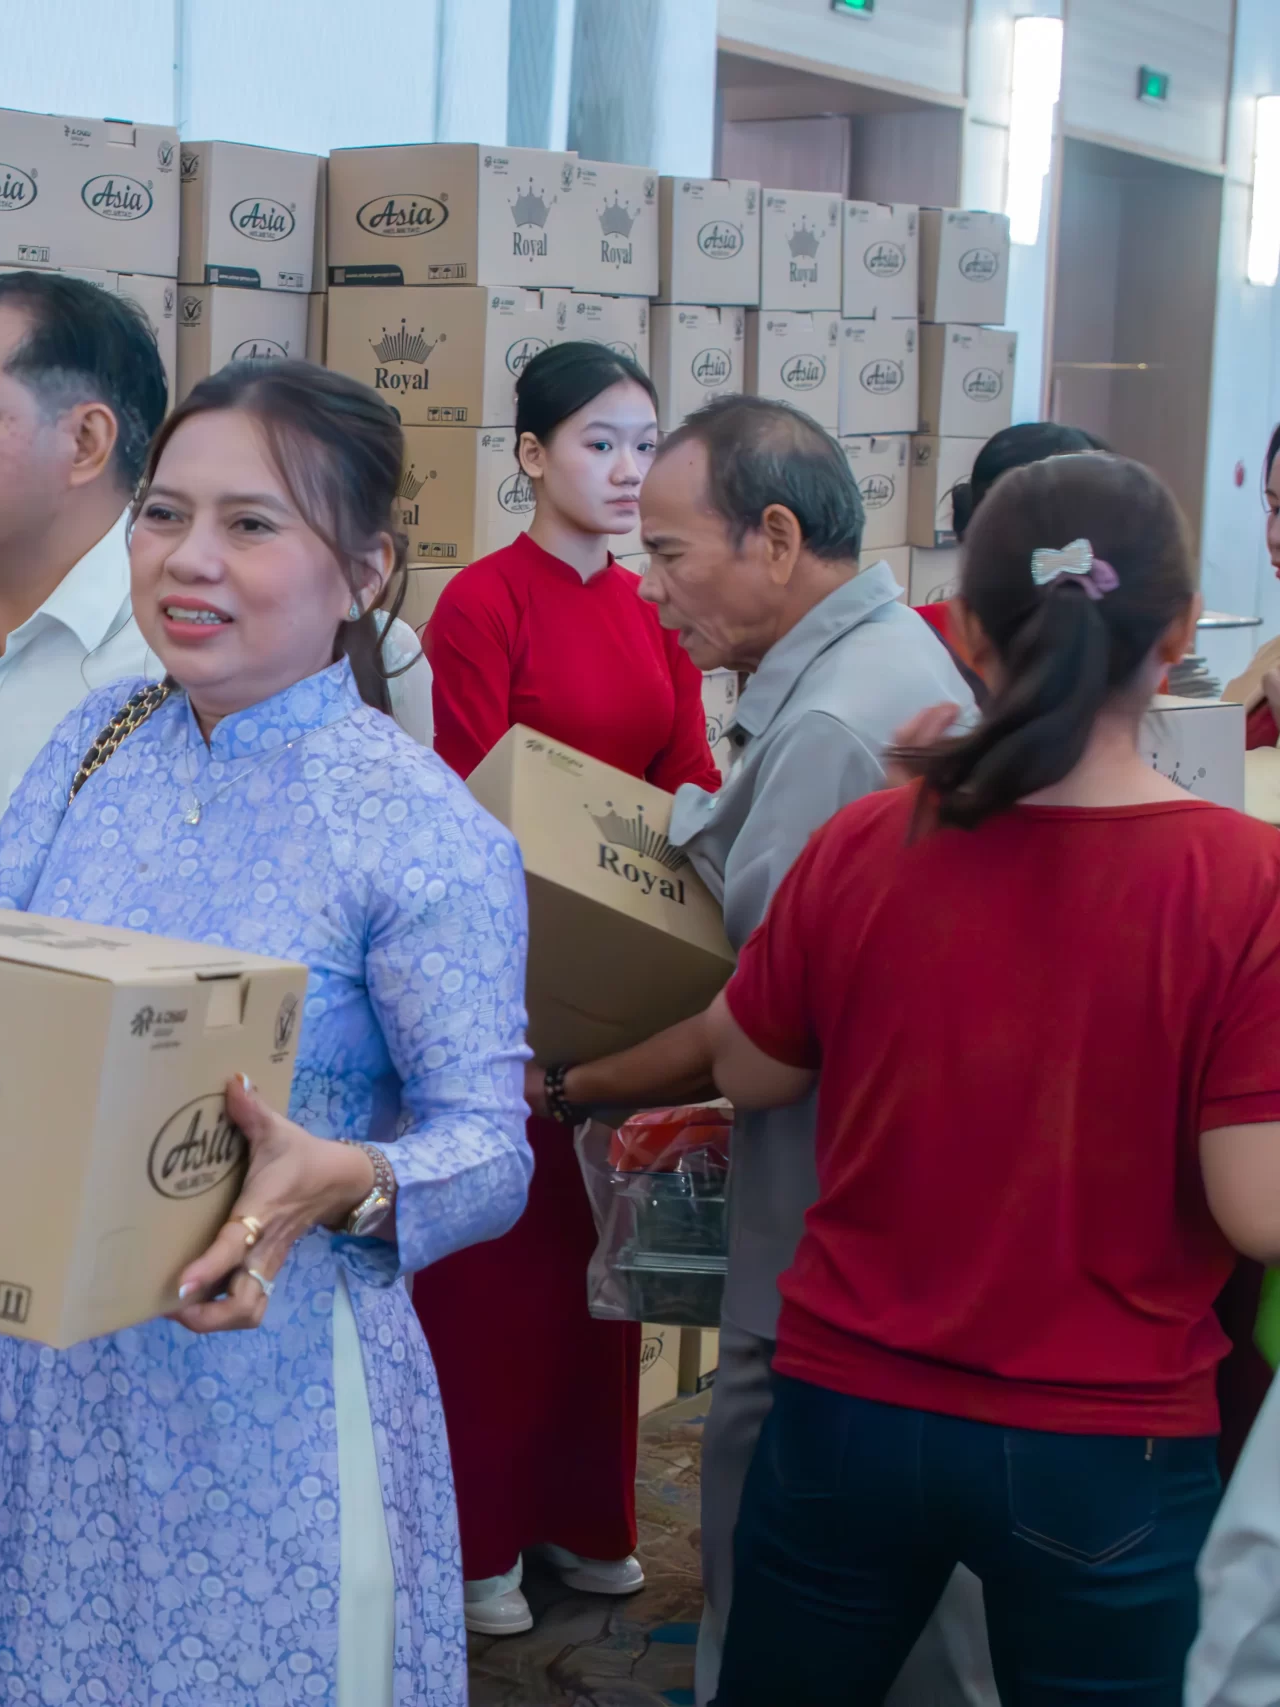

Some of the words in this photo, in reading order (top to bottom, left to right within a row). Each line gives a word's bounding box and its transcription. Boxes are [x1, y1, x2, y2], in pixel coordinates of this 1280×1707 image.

[92, 180, 143, 210] Asia
[239, 203, 286, 232] Asia
[369, 200, 435, 228] Asia
[513, 232, 547, 262] Royal
[704, 225, 737, 249] Asia
[601, 240, 632, 270] Royal
[374, 368, 429, 395] Royal
[597, 843, 686, 906] Royal
